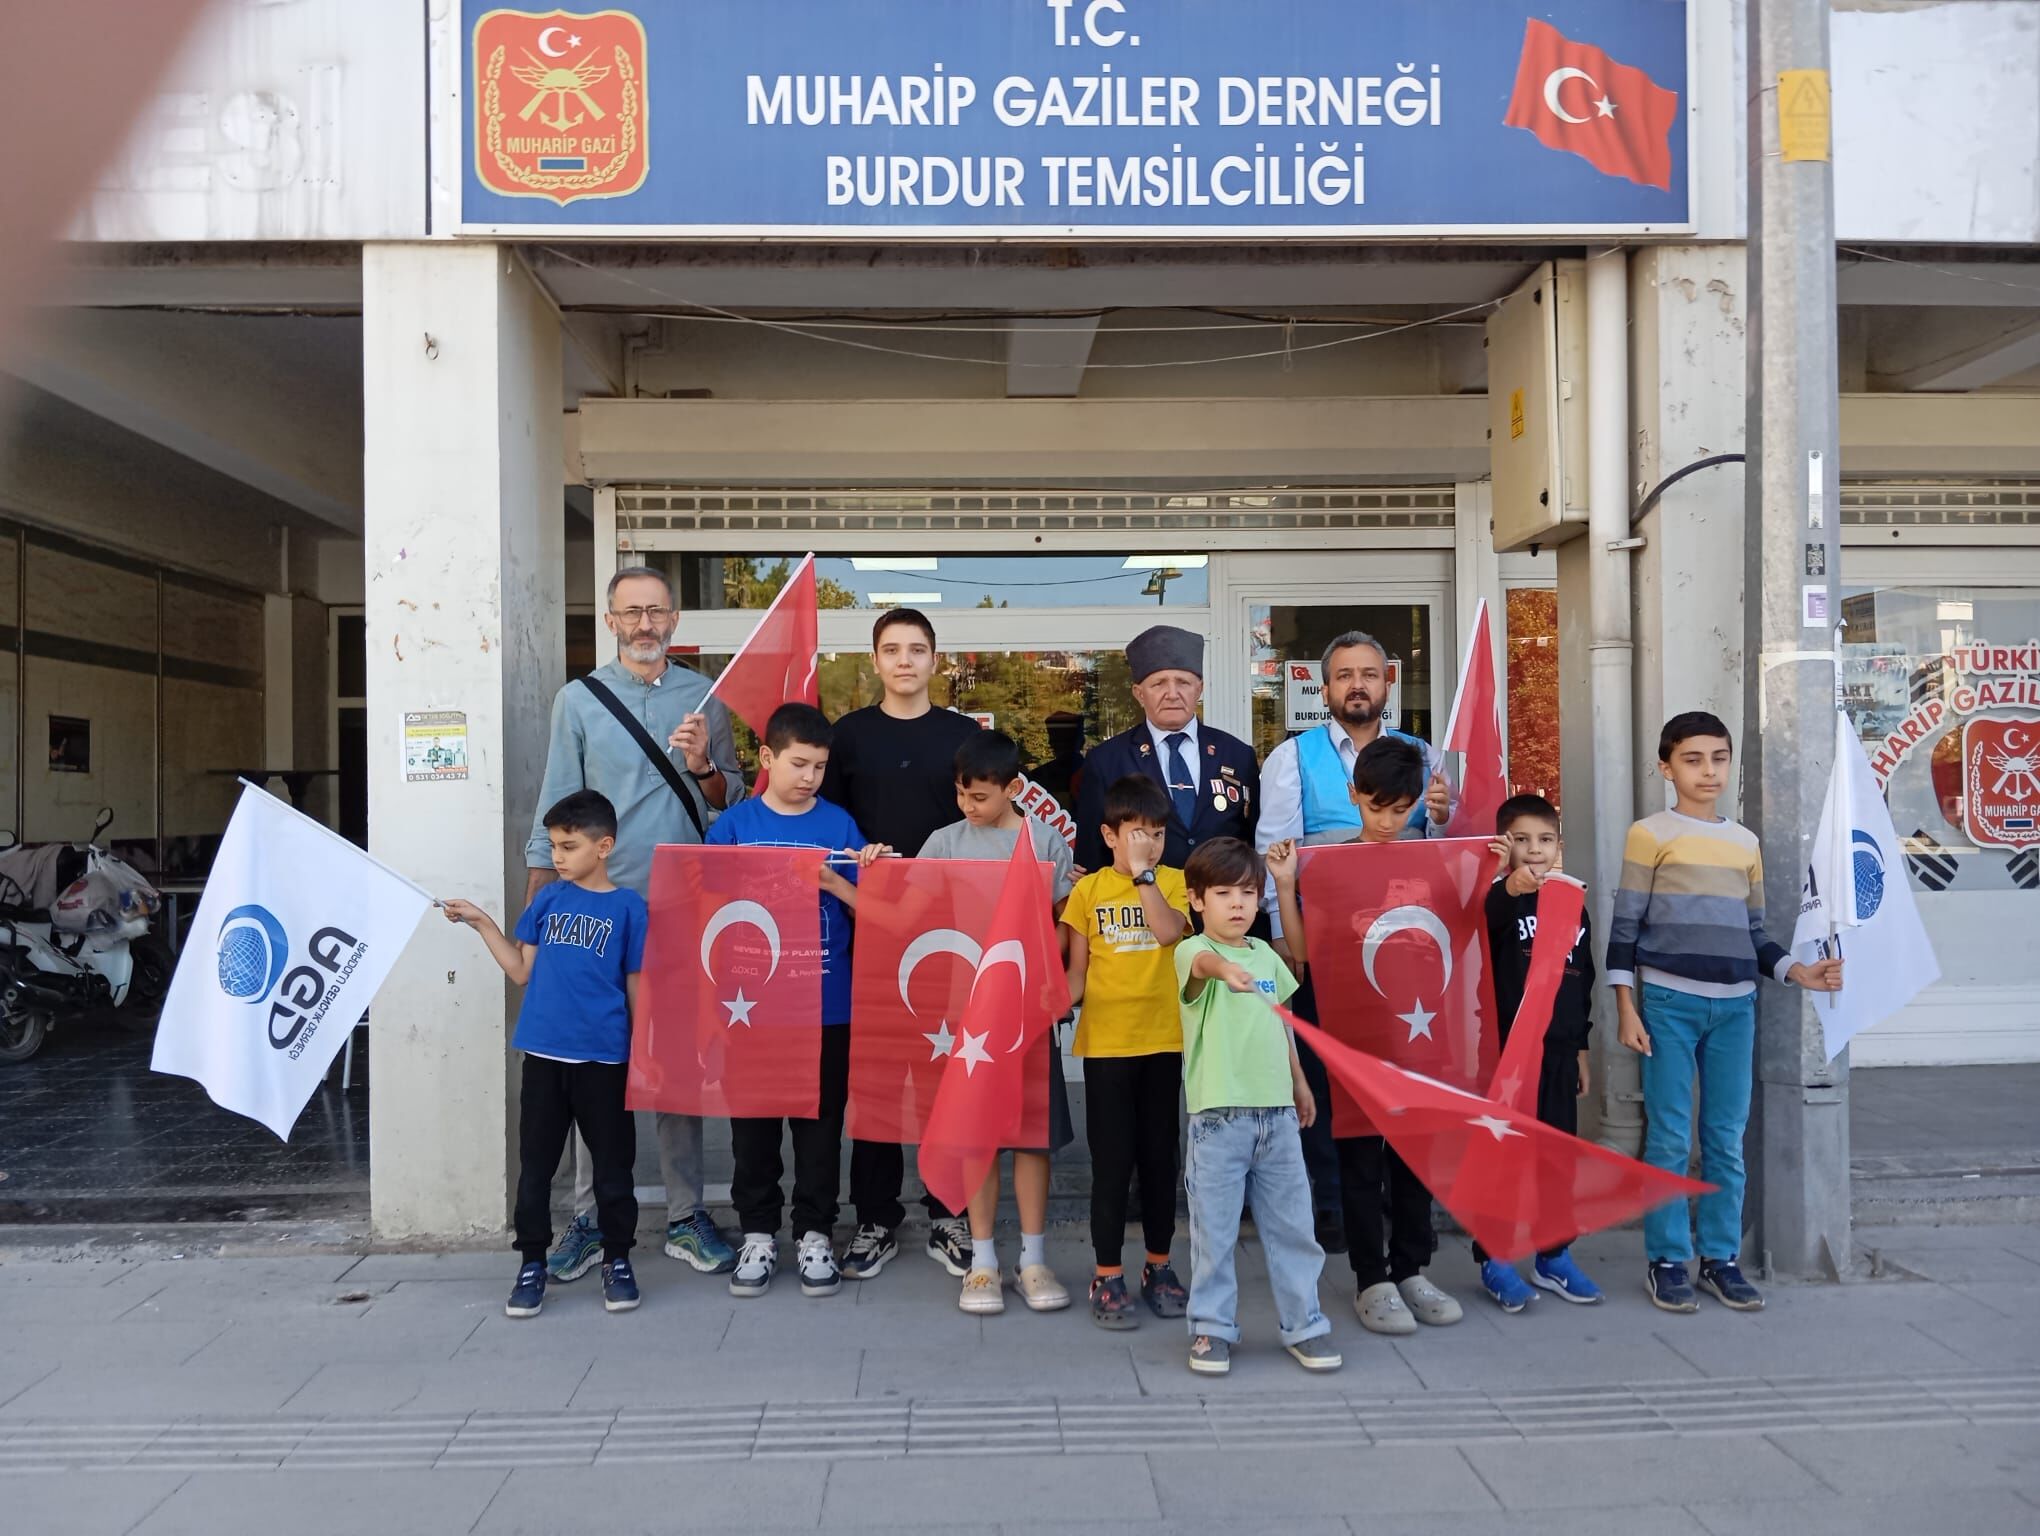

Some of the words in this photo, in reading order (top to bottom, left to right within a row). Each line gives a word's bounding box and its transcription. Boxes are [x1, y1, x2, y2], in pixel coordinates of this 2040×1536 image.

[1047, 0, 1140, 46] T.C.
[747, 63, 976, 126] MUHARİP
[992, 64, 1200, 127] GAZİLER
[1218, 63, 1441, 127] DERNEĞİ
[506, 134, 577, 154] MUHARİP
[581, 134, 616, 154] GAZİ
[827, 156, 1024, 206] BURDUR
[1041, 142, 1365, 207] TEMSİLCİLİĞİ
[1955, 643, 2040, 671] TÜRKİ
[545, 913, 613, 957] MAVİ
